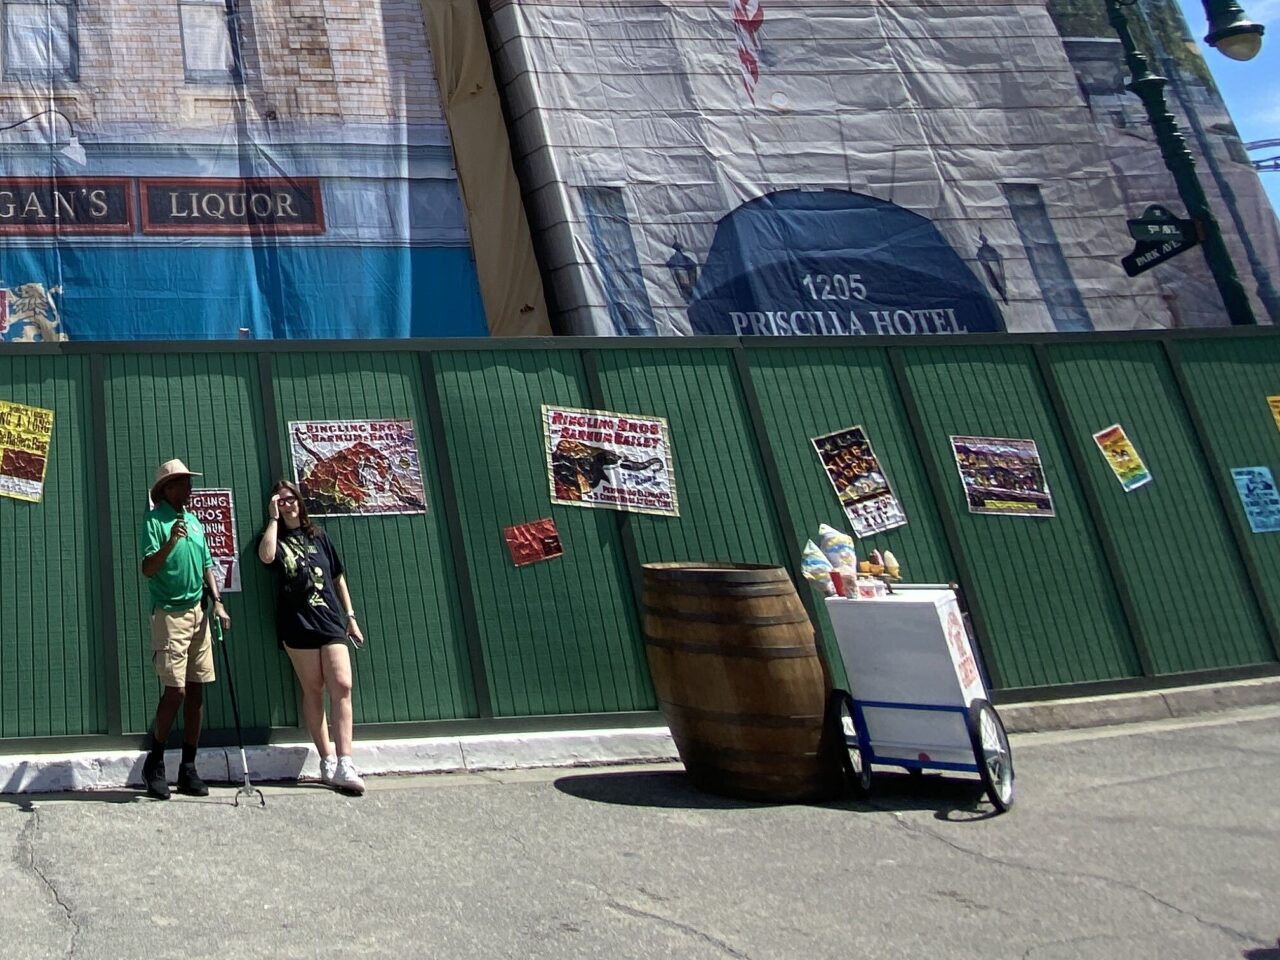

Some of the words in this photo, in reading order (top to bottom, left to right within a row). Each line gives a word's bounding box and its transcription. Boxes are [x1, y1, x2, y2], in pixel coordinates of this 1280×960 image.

[169, 192, 298, 219] LIQUOR
[1136, 248, 1160, 266] PARK
[803, 273, 867, 300] 1205
[729, 310, 868, 336] PRISCILLA
[869, 308, 967, 335] HOTEL
[305, 424, 367, 433] RINGLING
[551, 412, 614, 430] RINGLING
[617, 418, 660, 436] BROS
[311, 432, 362, 442] BARNUM
[560, 427, 613, 444] BARNUM
[614, 431, 660, 449] BAILEY
[207, 536, 226, 547] ILEY
